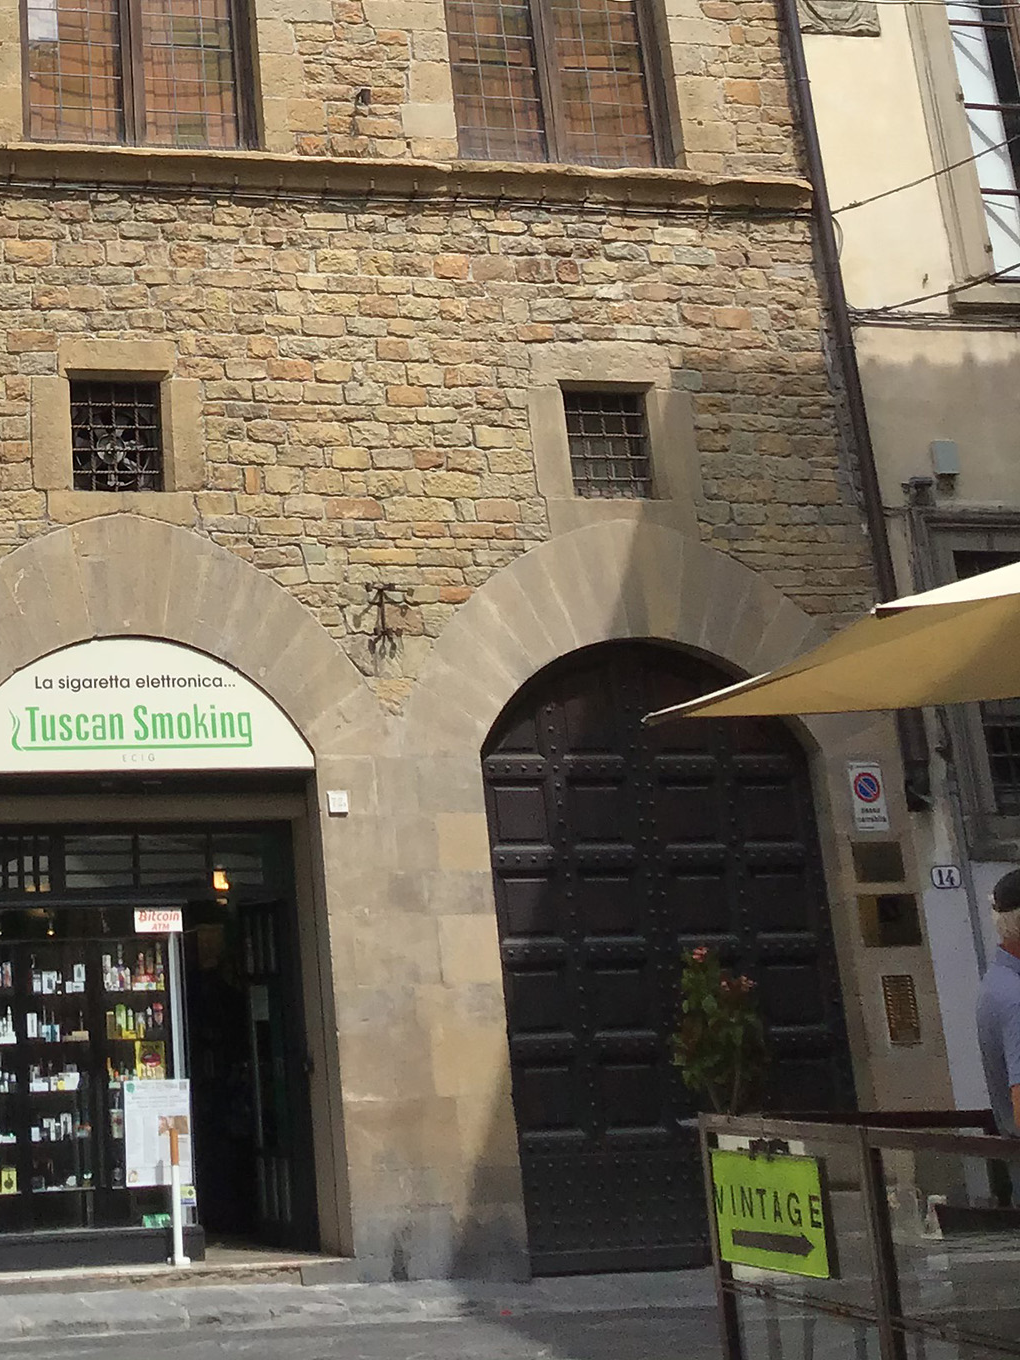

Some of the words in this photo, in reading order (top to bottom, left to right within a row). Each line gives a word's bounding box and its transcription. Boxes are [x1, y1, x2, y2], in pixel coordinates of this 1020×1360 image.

[35, 676, 53, 690] La
[58, 675, 131, 693] sigaretta
[135, 674, 236, 688] elettronica...
[25, 706, 125, 742] Tuscan
[133, 704, 253, 747] Smoking
[937, 869, 956, 886] 14
[138, 909, 180, 921] Bitcoin
[151, 923, 170, 931] ATM
[712, 1182, 823, 1229] VINTAGE
